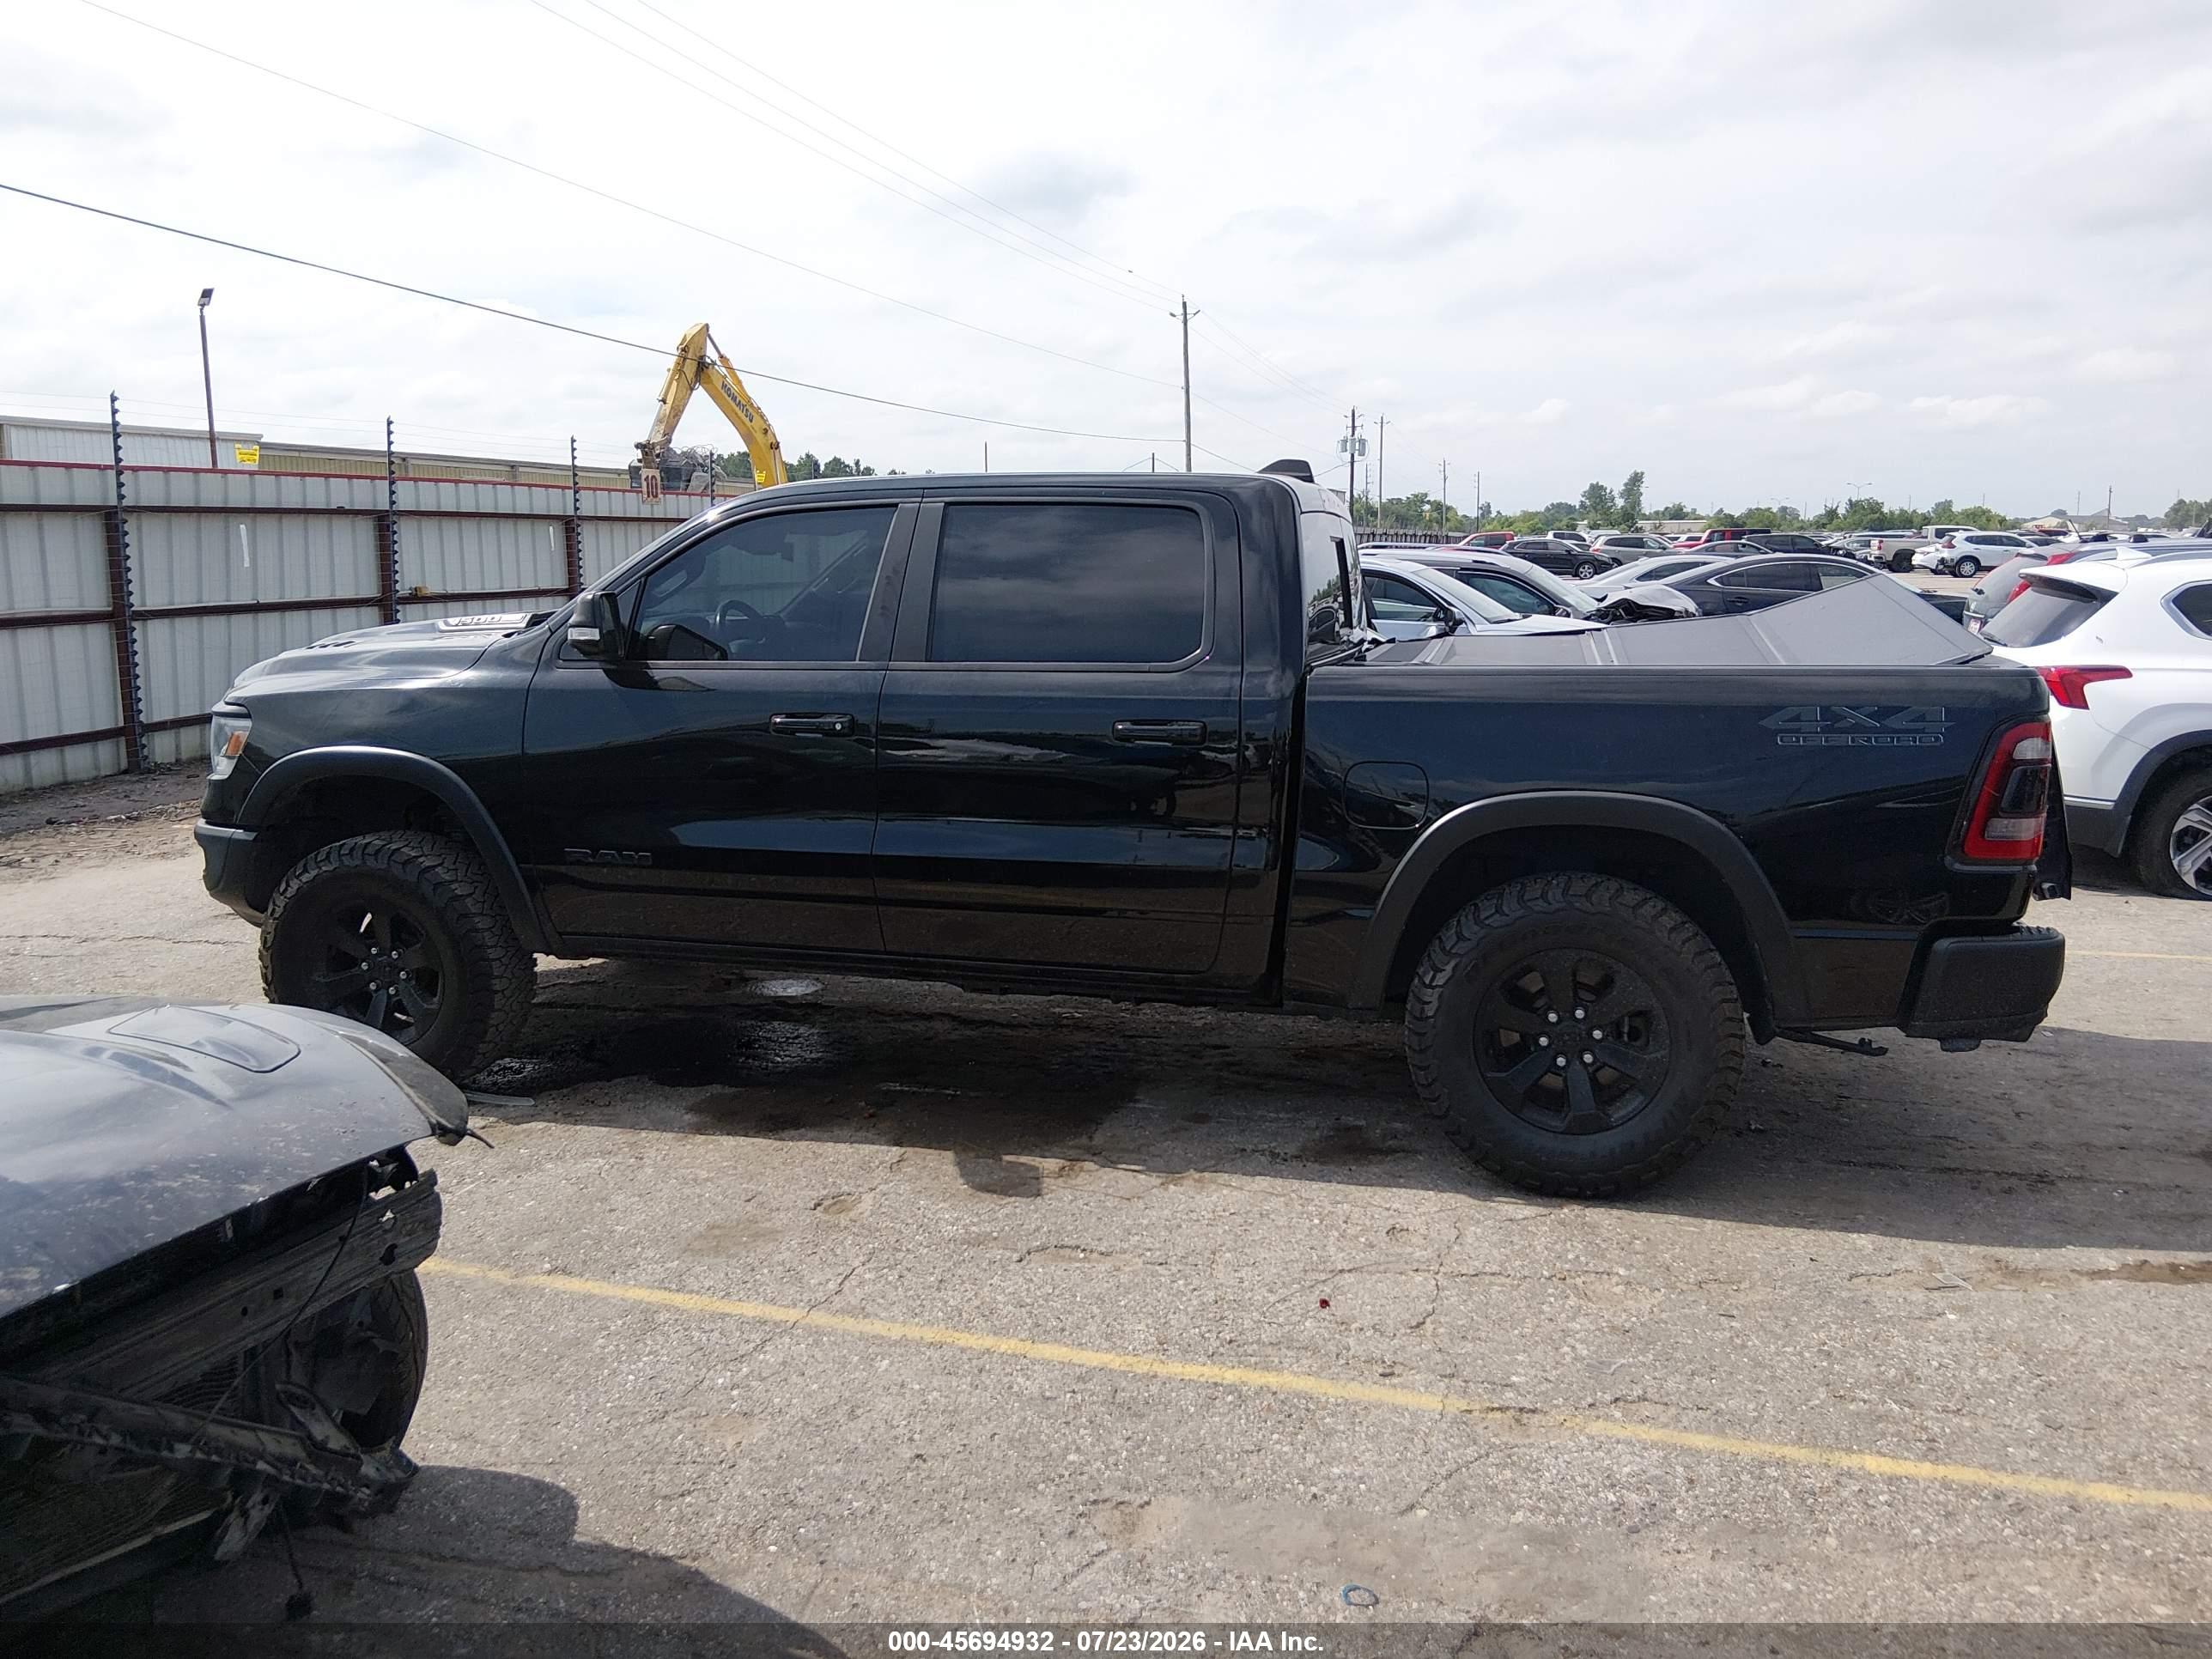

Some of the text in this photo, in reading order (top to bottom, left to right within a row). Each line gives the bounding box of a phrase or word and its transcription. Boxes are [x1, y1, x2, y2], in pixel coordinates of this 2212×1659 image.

[720, 380, 754, 423] KOMATSU
[644, 474, 659, 498] 10
[563, 847, 653, 865] RAM
